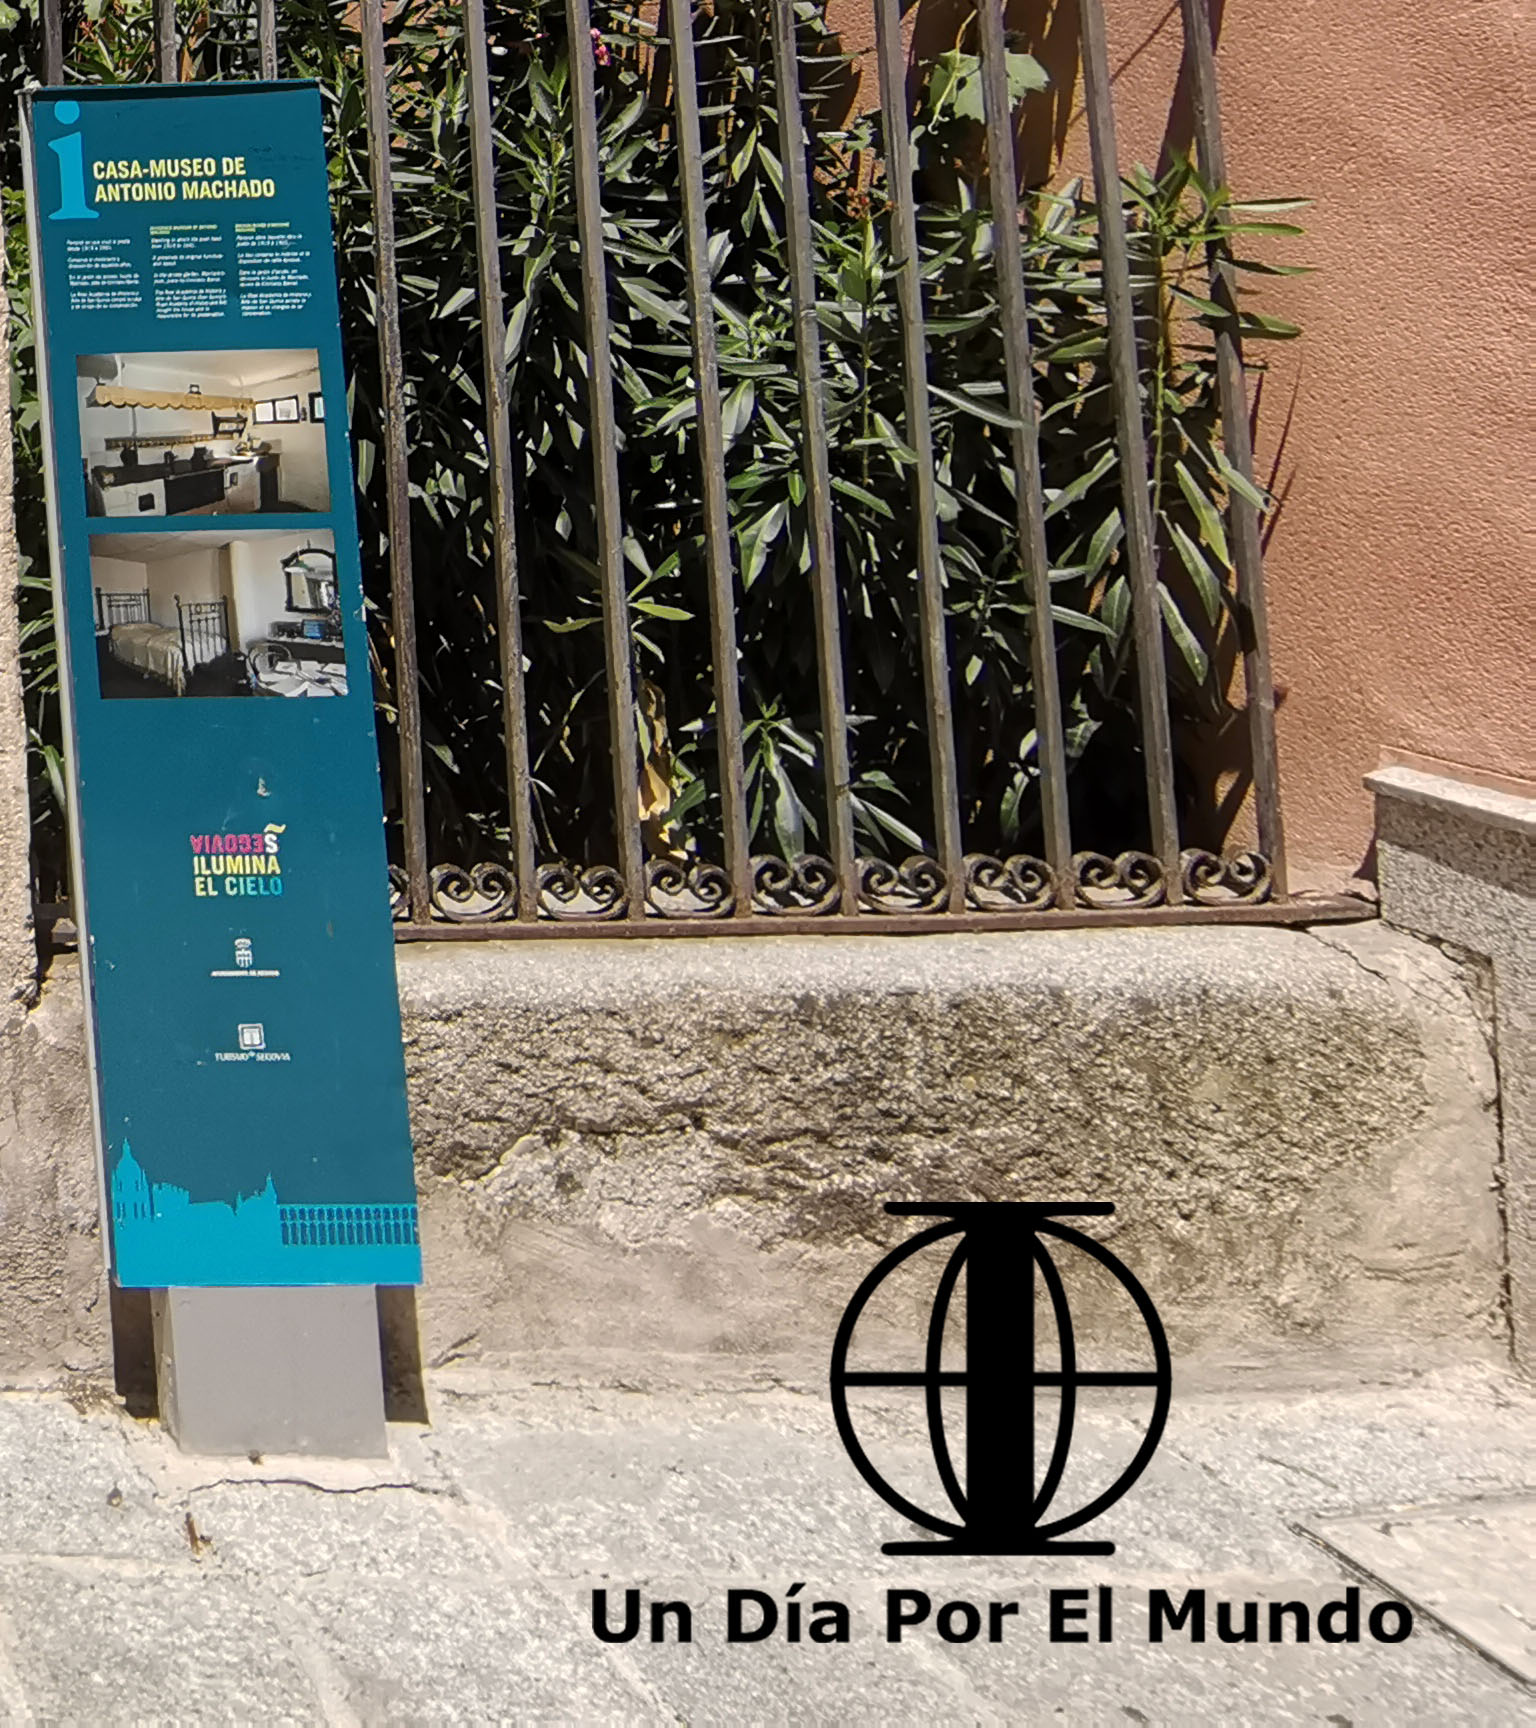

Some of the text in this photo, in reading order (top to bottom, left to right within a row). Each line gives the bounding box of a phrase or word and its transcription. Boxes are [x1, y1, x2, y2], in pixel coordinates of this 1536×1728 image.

[92, 157, 247, 180] CASA-MUSEO DE
[94, 179, 275, 203] ANTONIO MACHADO
[193, 855, 281, 875] ILUMINA
[194, 876, 283, 897] EL CIELO
